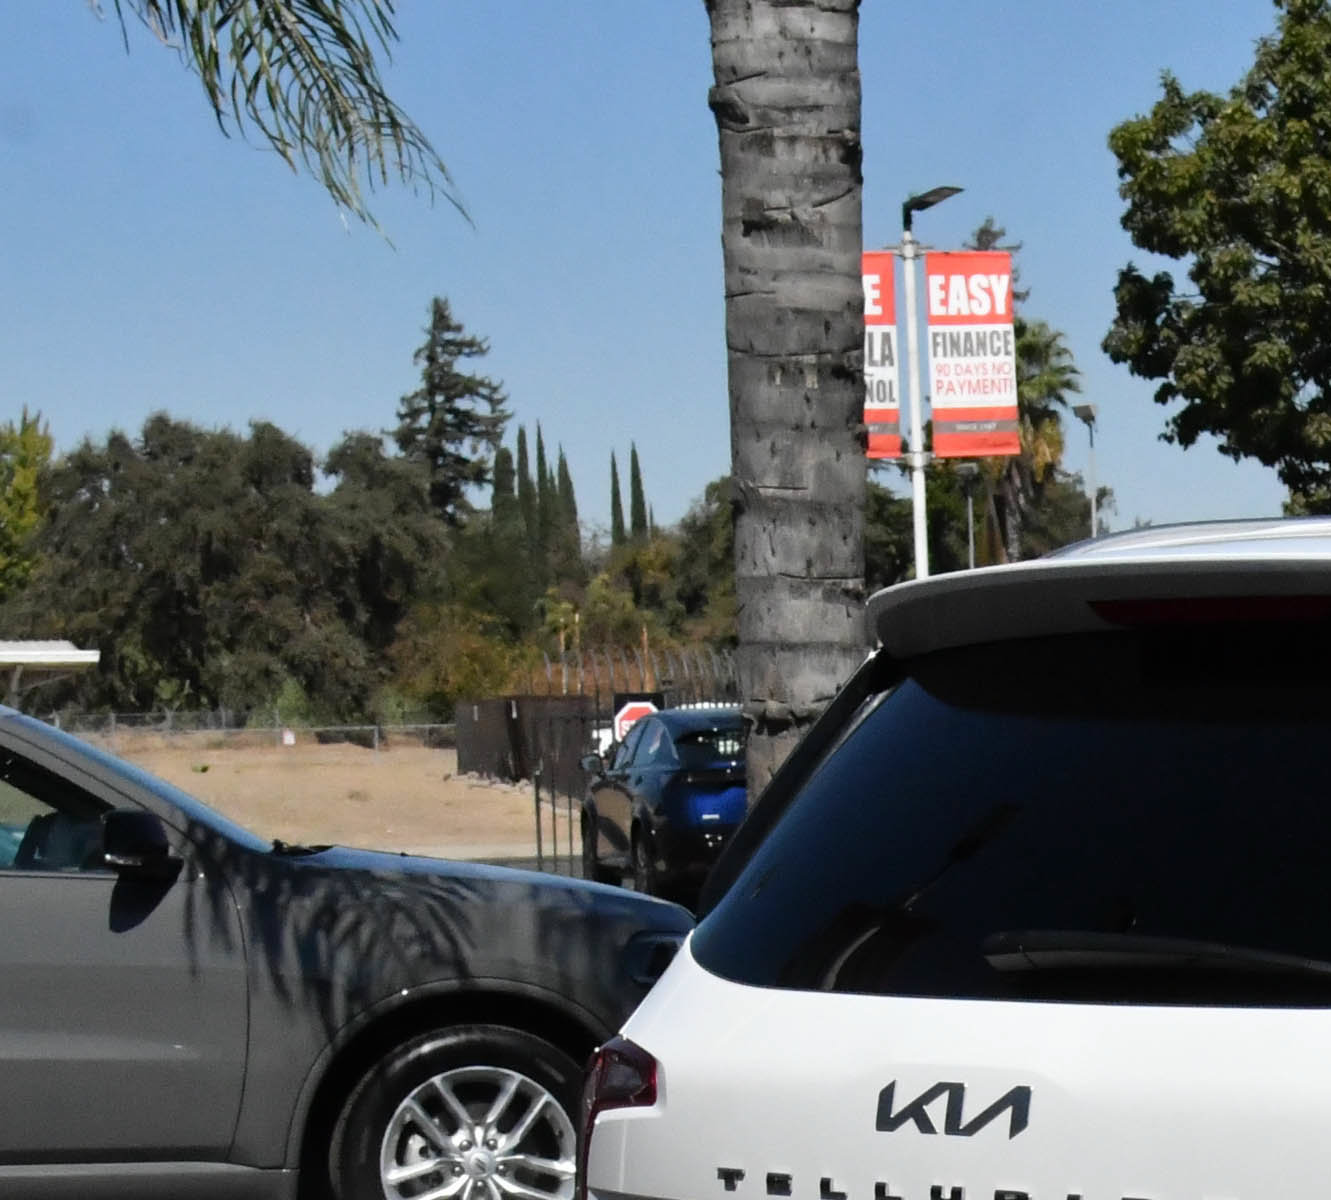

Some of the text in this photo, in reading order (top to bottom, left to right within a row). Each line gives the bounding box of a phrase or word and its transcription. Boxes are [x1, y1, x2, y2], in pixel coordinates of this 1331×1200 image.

[928, 274, 1010, 316] EASY
[931, 329, 1013, 358] FINANCE
[935, 360, 1012, 376] 90 DAYS NO
[875, 1079, 1032, 1141] KIA
